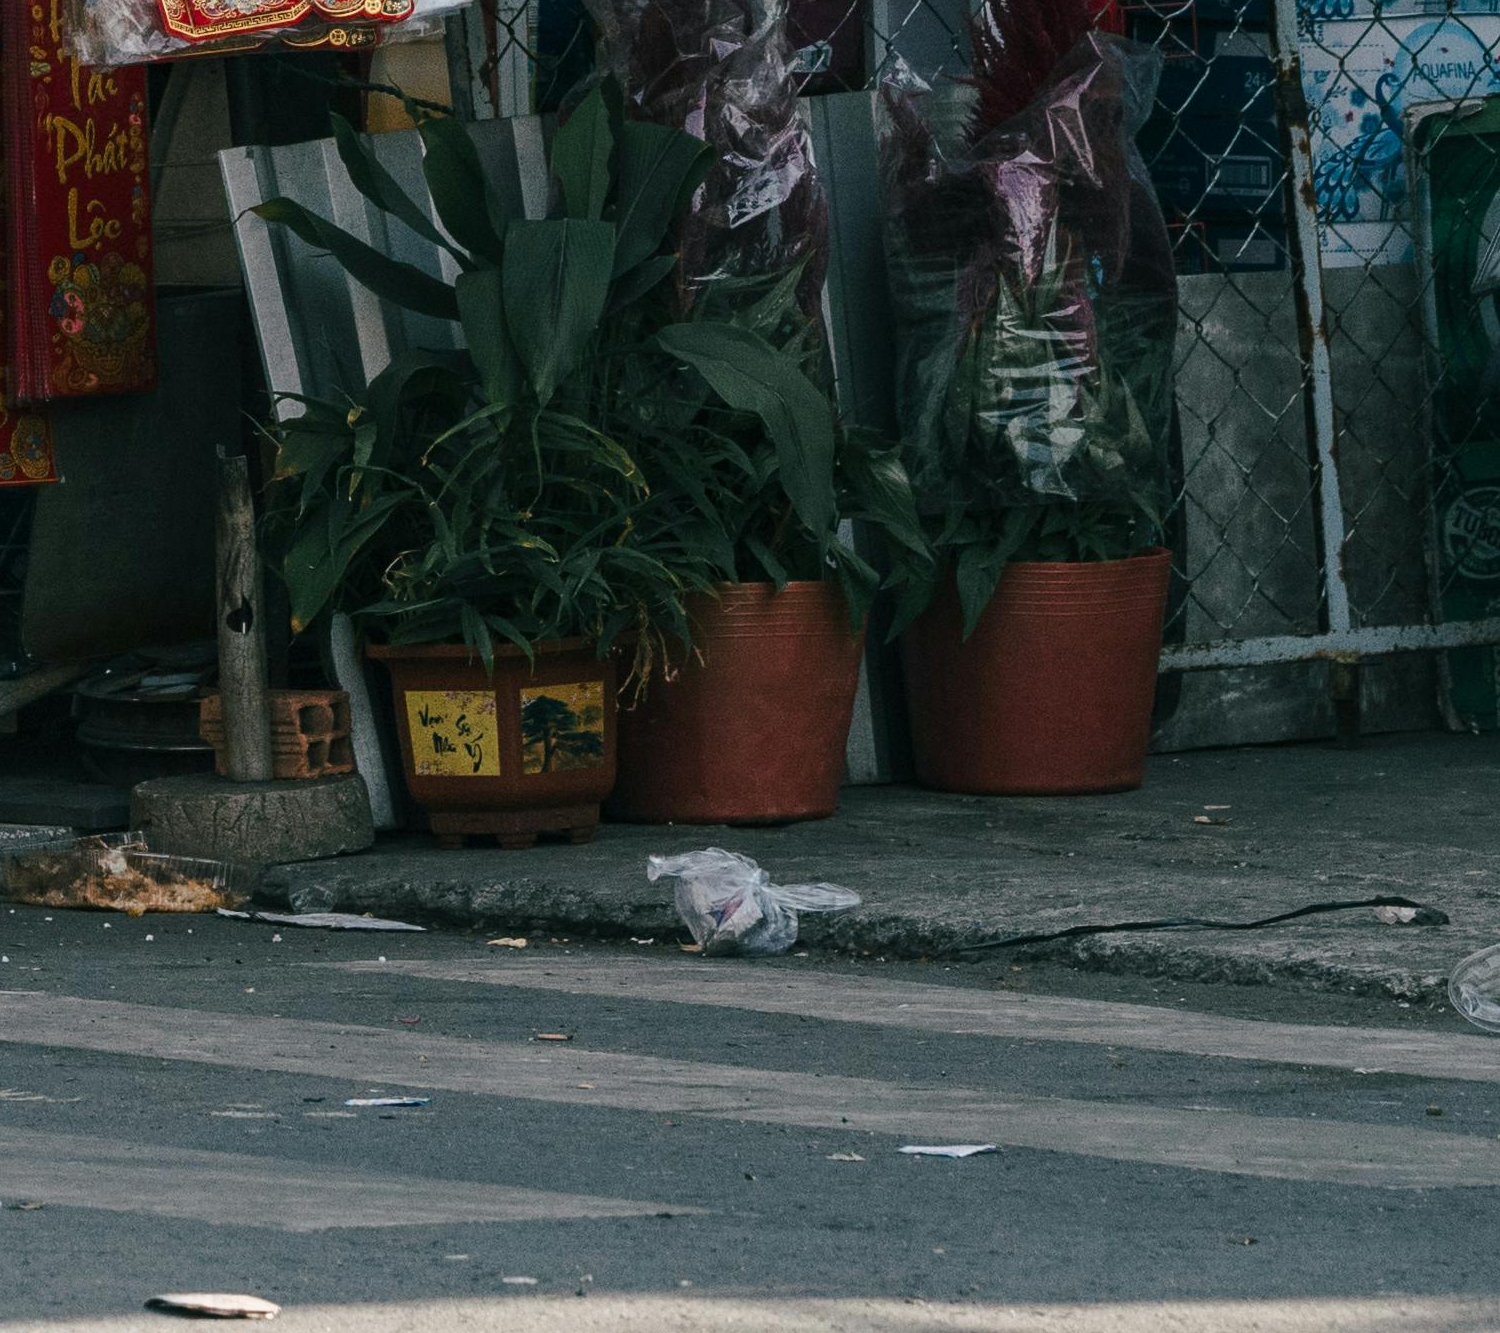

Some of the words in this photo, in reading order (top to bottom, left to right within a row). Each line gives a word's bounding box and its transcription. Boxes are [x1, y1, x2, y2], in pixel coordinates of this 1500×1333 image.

[1413, 62, 1482, 82] AQUAFINA
[46, 110, 131, 186] Phát
[68, 185, 122, 253] Lộc
